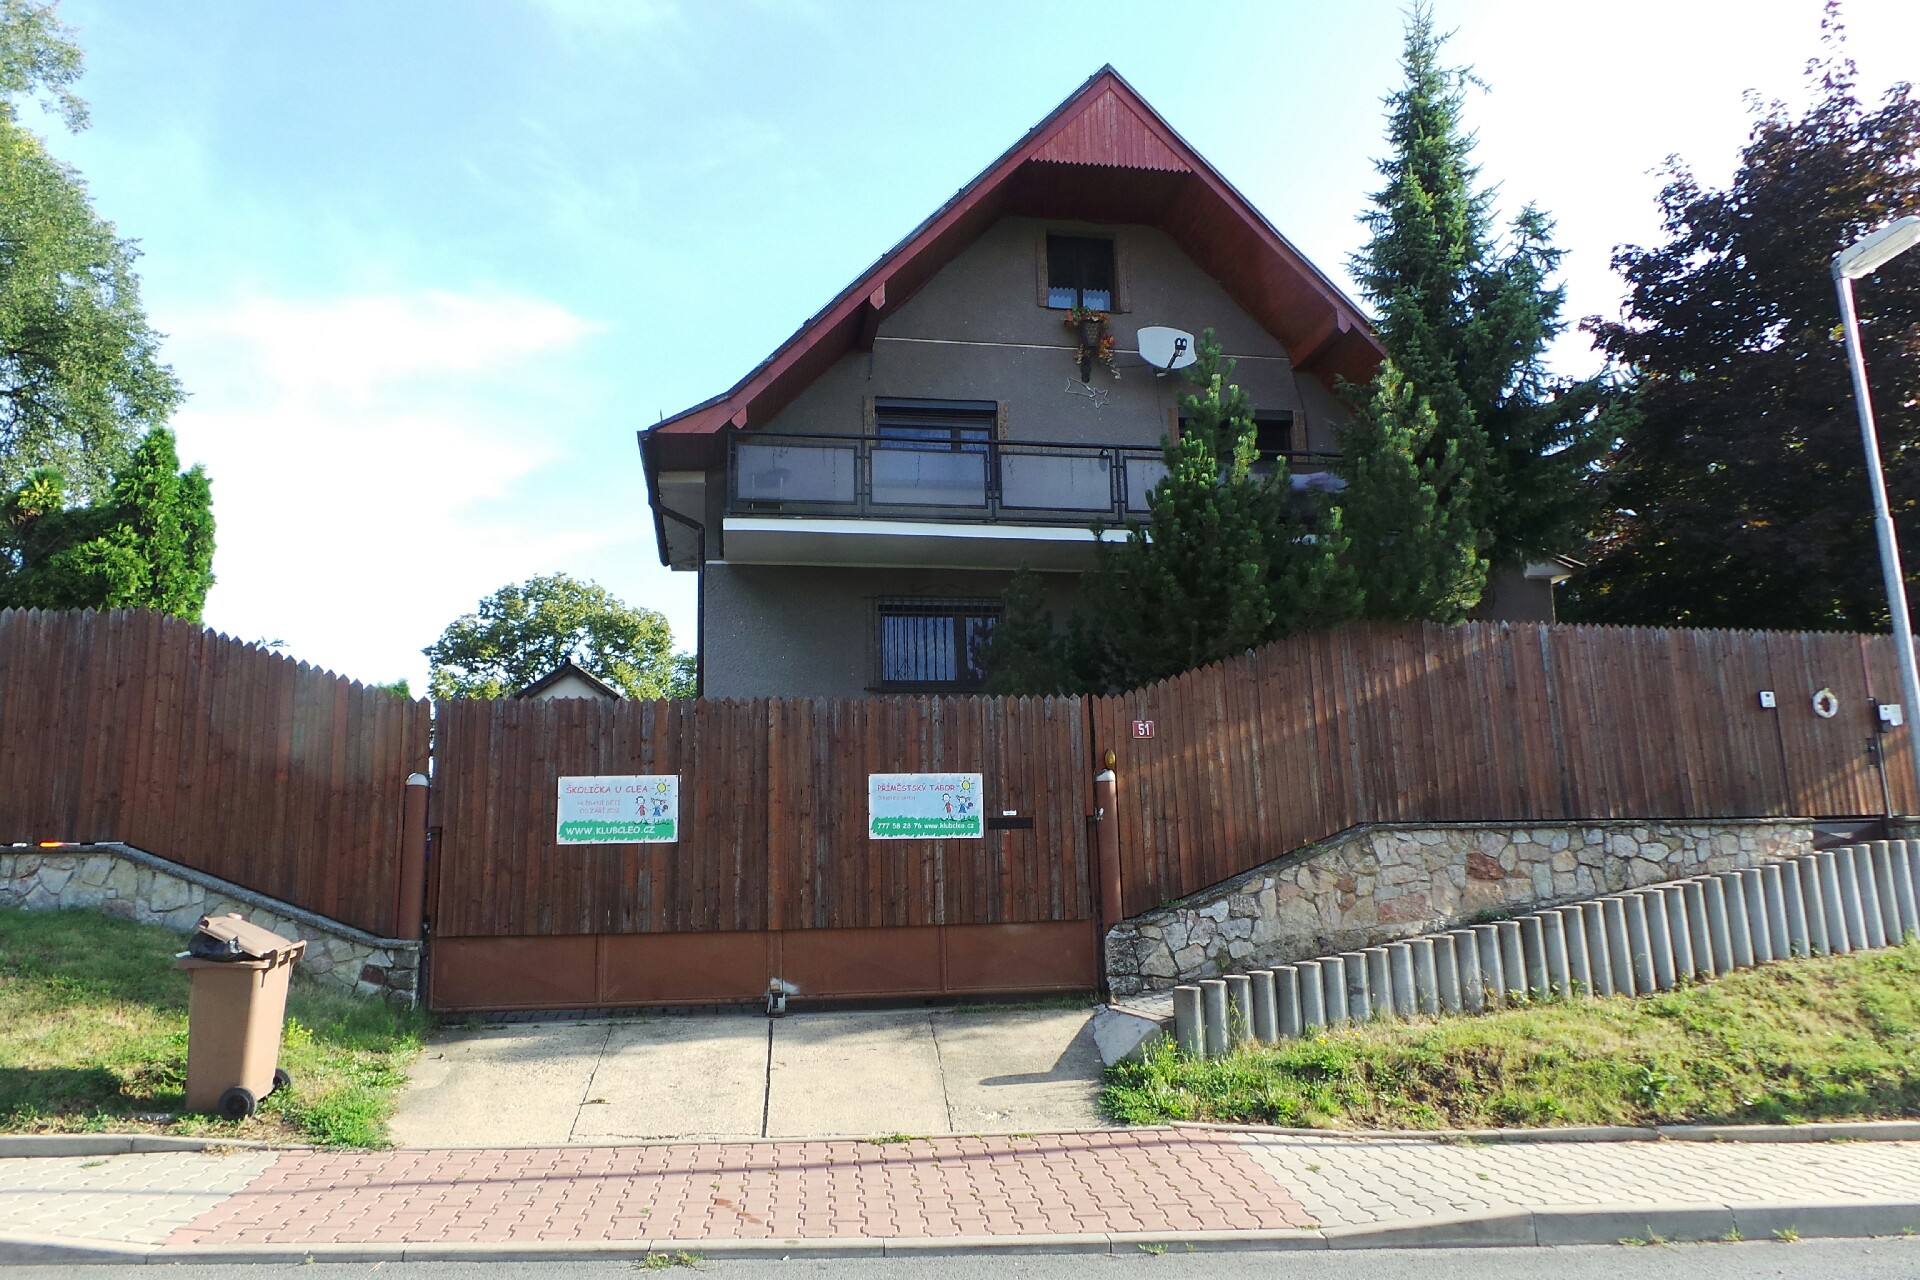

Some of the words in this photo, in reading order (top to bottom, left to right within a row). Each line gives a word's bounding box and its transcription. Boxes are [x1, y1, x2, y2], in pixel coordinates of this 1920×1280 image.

[1138, 723, 1150, 736] 51
[565, 784, 611, 794] ŠKOLIČKA
[625, 785, 648, 793] CLEA
[877, 783, 926, 792] PŘÍMĚSTSKÝ
[929, 783, 956, 792] TÁBOR
[565, 826, 656, 836] WWW.KLUBCLEO.CZ
